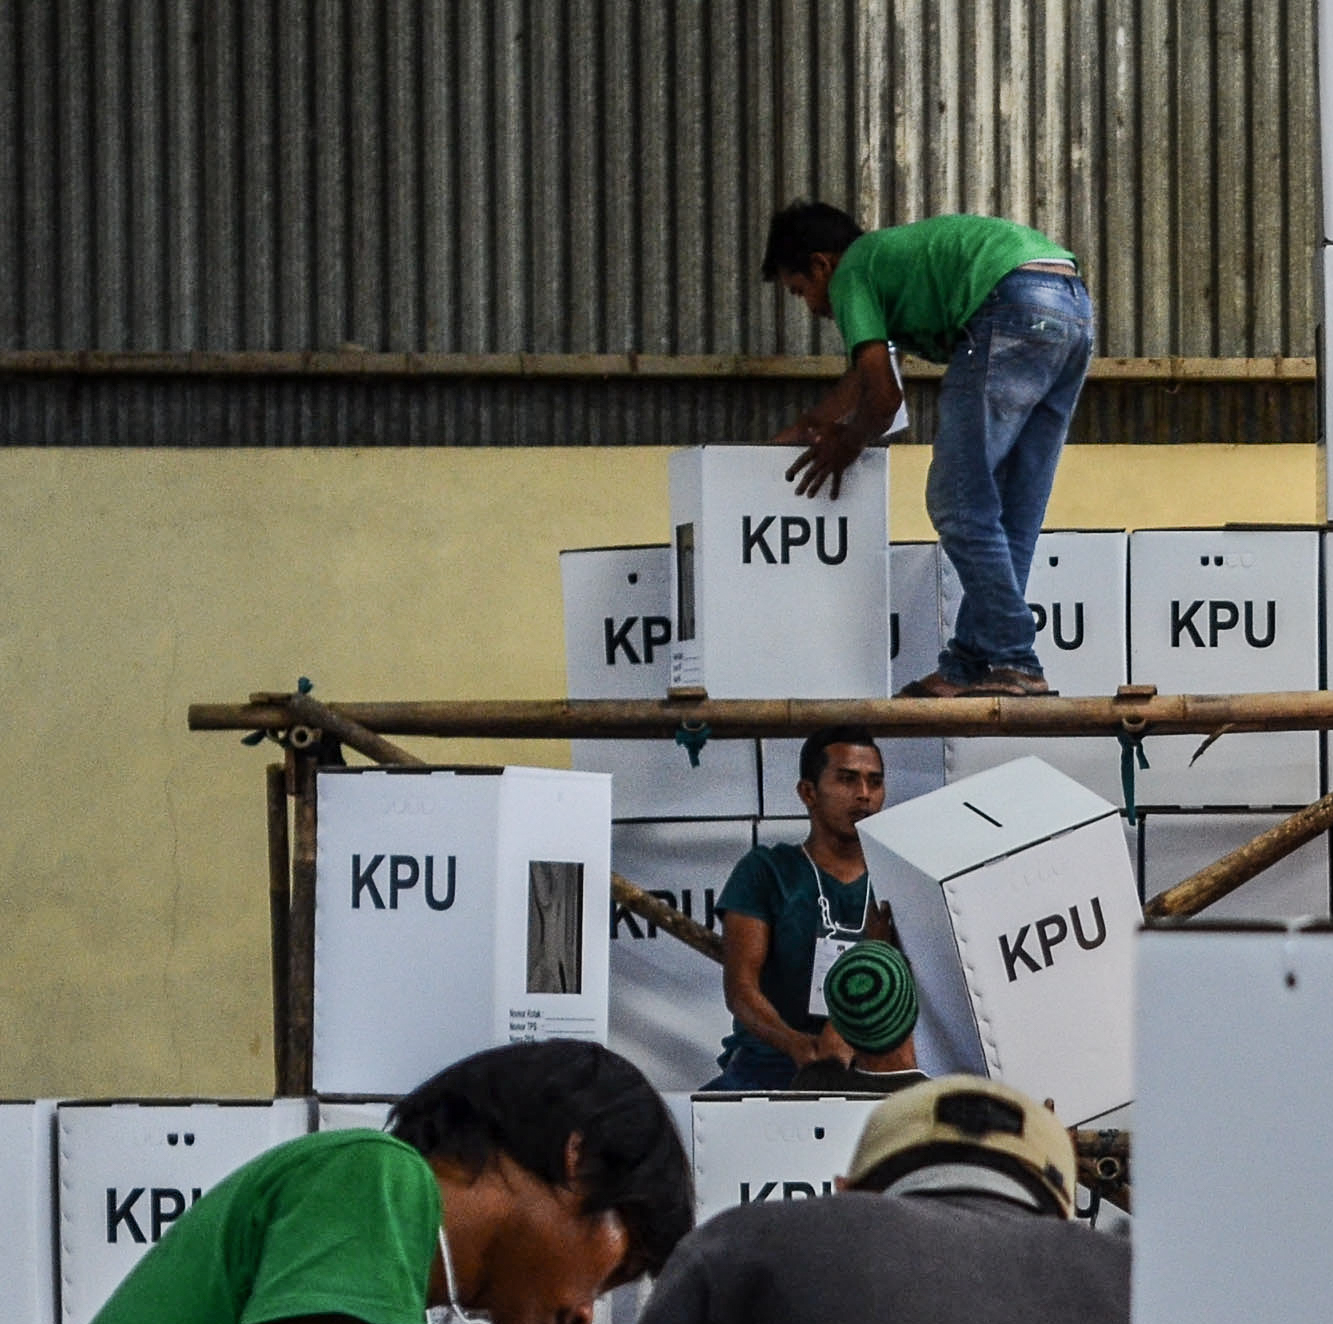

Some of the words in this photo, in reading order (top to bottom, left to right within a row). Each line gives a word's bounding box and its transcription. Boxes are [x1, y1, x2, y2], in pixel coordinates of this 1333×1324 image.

[742, 515, 848, 566] KPU
[605, 616, 671, 665] KP
[1027, 602, 1084, 650] PU
[1170, 599, 1276, 649] KPU
[351, 853, 457, 912] KPU
[998, 896, 1107, 983] KPU
[106, 1187, 202, 1243] KP
